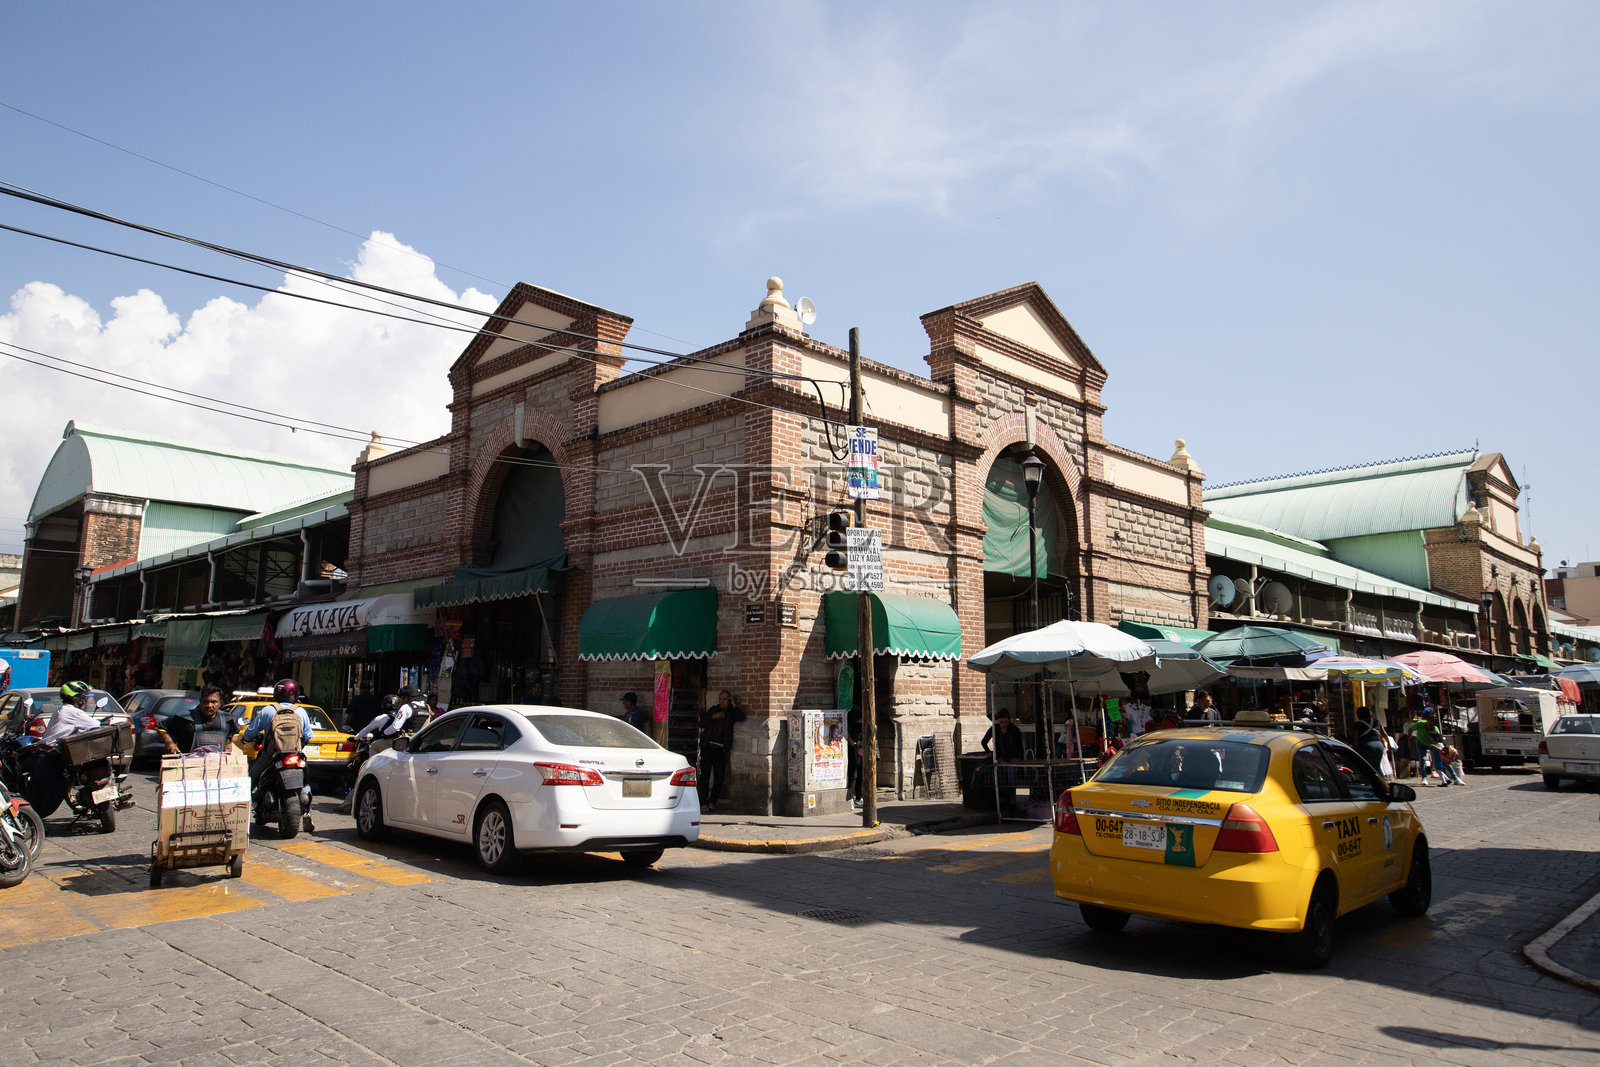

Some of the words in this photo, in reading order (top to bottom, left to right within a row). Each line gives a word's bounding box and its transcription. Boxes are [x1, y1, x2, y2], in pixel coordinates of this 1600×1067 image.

[856, 428, 866, 438] SE
[849, 554, 860, 562] LUZ
[866, 555, 881, 563] AGUA
[1156, 798, 1171, 806] SITIO
[1172, 799, 1220, 811] INDEPENDENCIA
[1335, 816, 1360, 839] TAXI
[1124, 828, 1165, 843] 28-18-SJP
